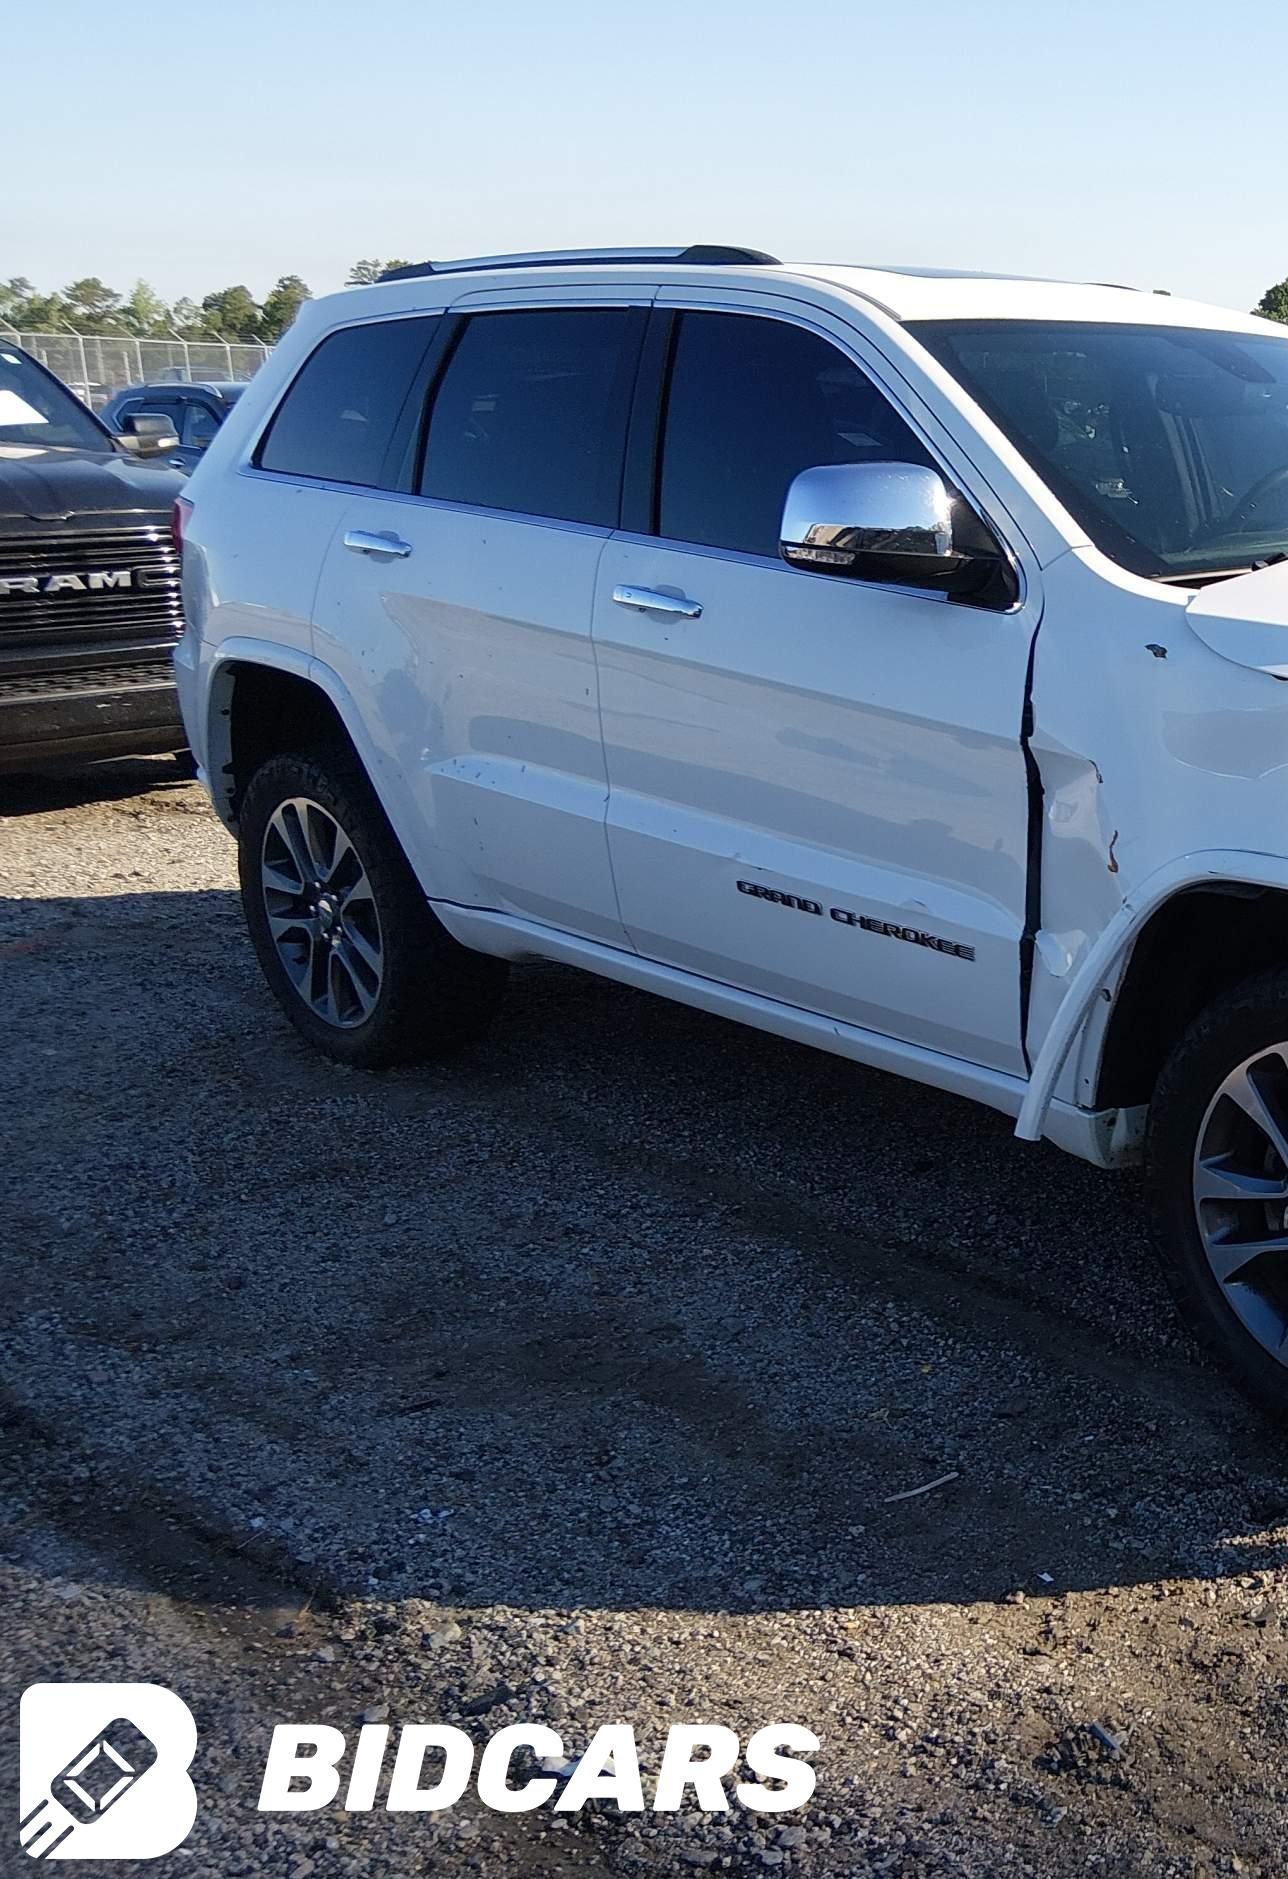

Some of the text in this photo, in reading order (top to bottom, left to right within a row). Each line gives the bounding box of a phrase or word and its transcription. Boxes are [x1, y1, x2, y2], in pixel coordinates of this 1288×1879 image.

[0, 571, 132, 594] RAM
[736, 880, 976, 961] GRAND CHEROKEE
